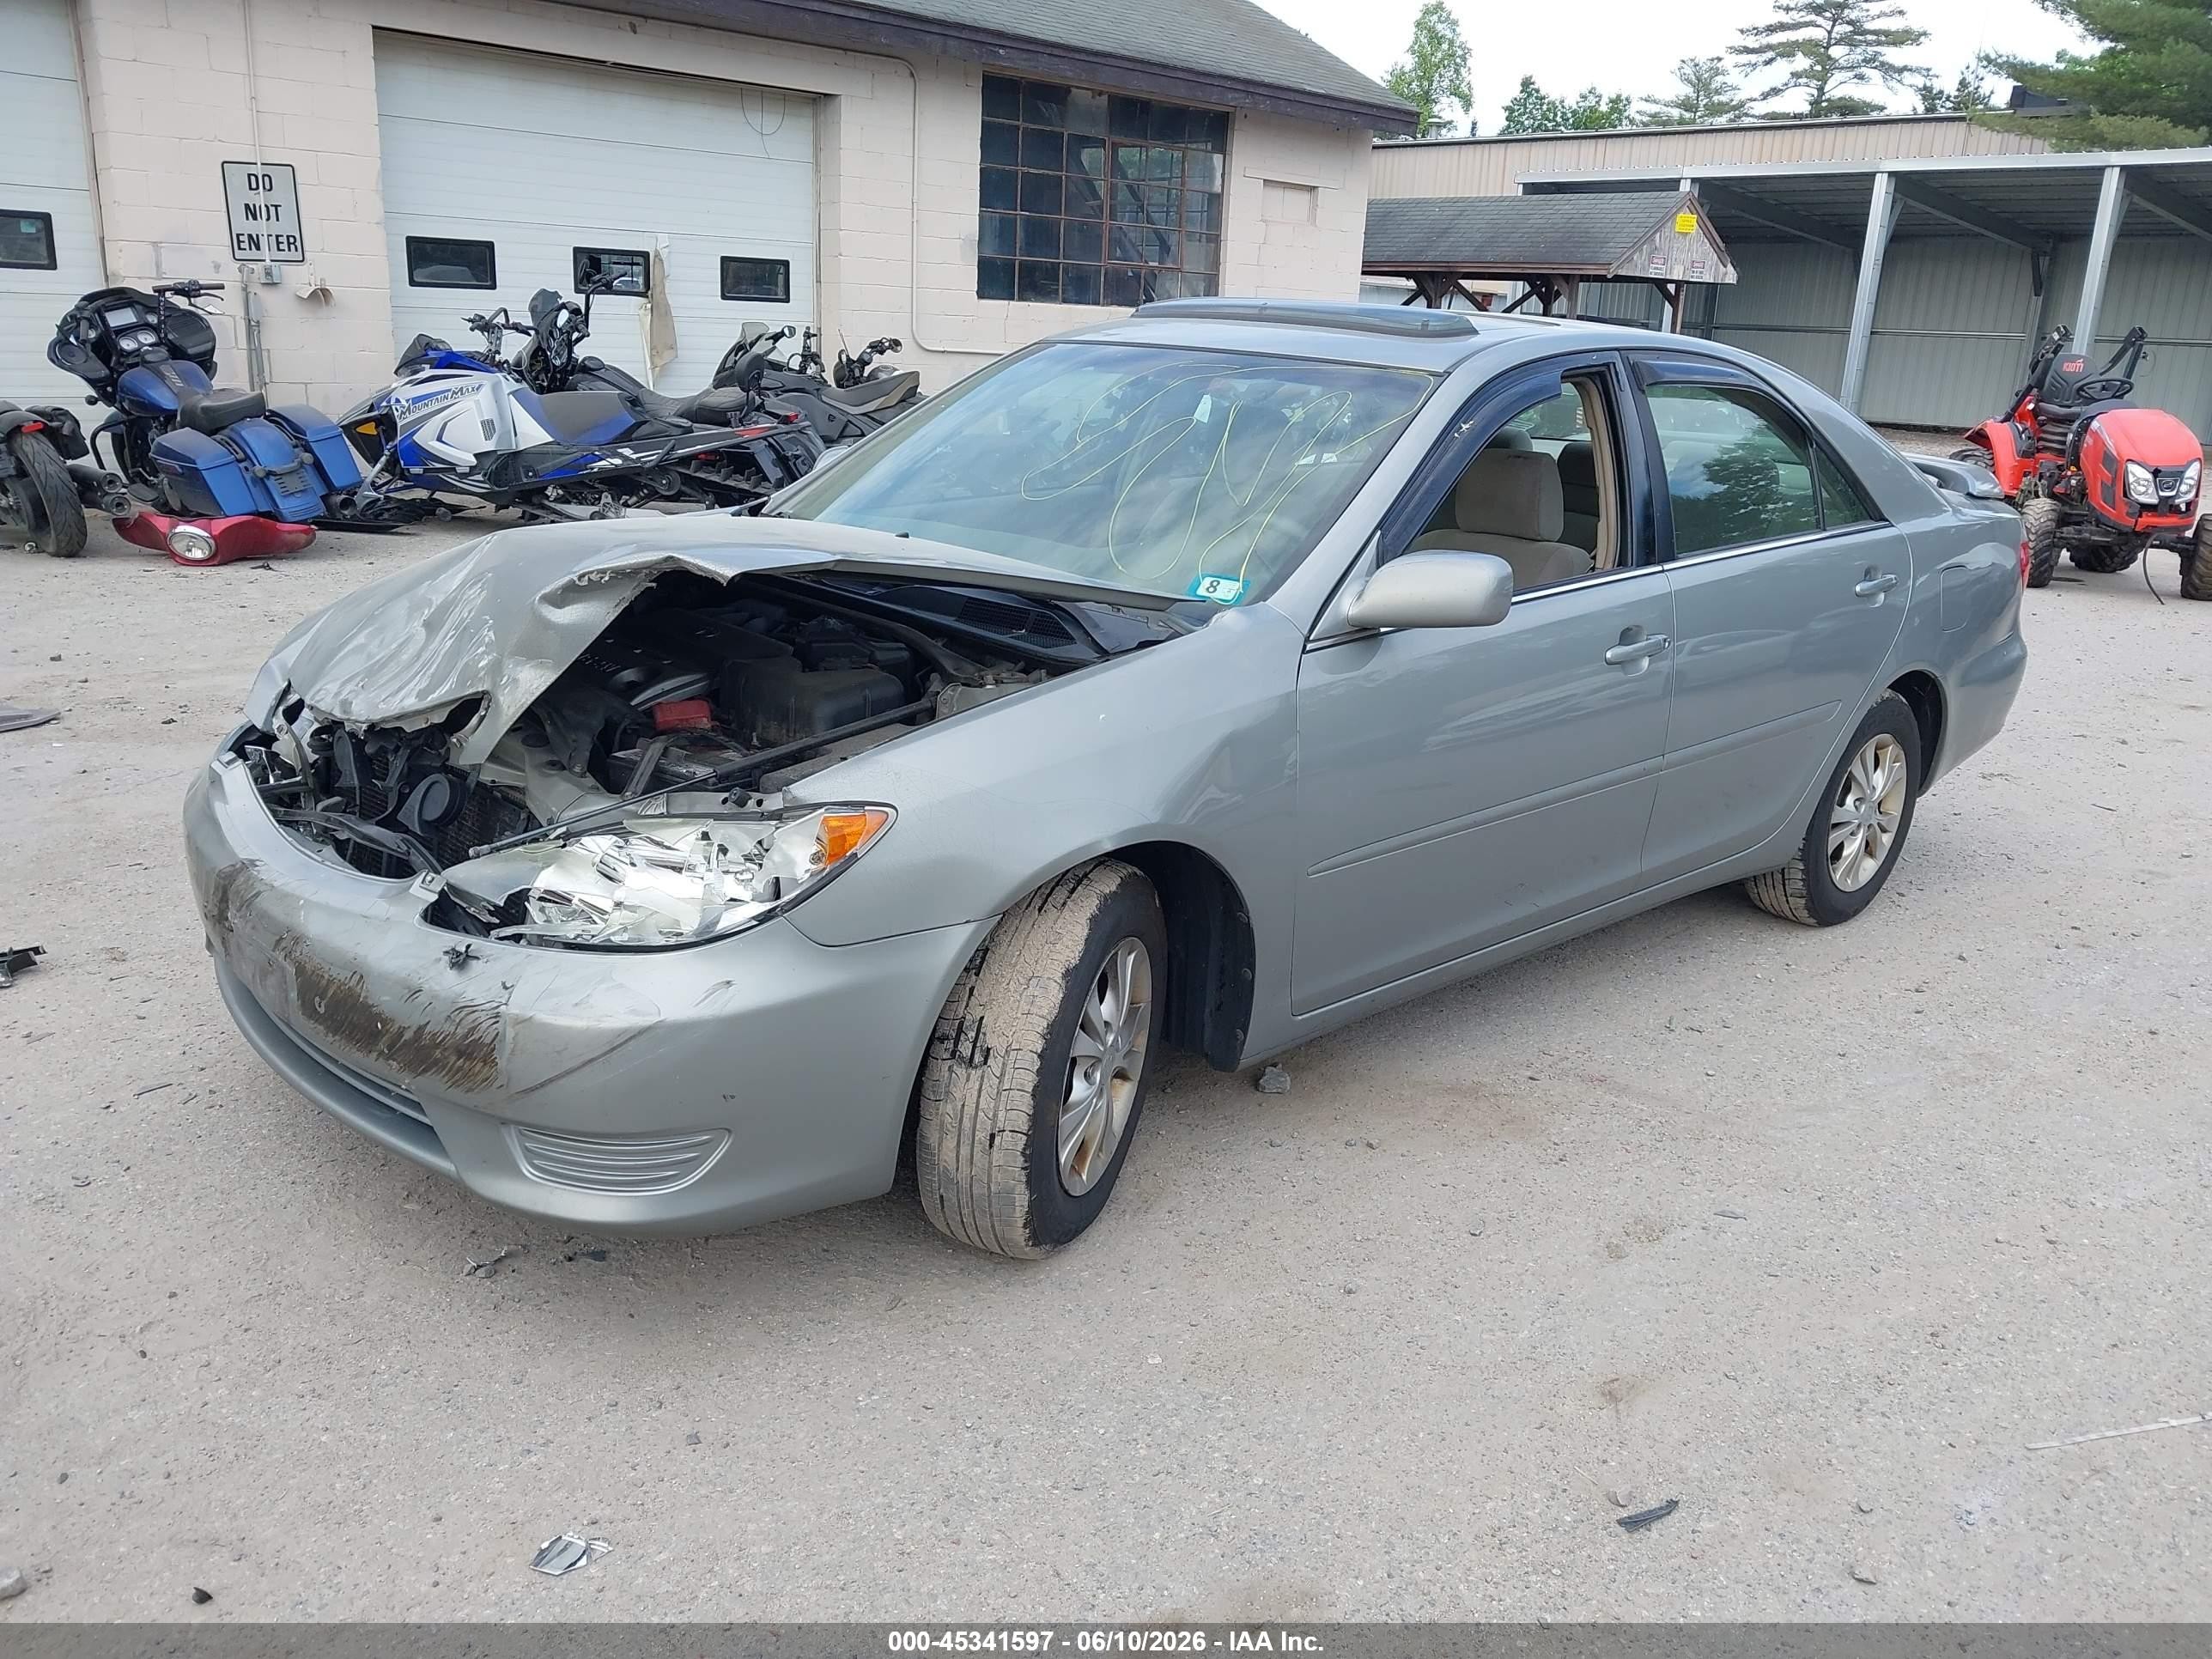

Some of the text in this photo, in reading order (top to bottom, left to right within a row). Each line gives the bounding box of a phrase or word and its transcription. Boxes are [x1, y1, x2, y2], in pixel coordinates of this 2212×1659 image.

[247, 173, 273, 191] DO
[244, 203, 282, 222] NOT
[235, 234, 298, 252] ENTER
[398, 392, 450, 420] MOUNTAIN
[1206, 580, 1220, 593] 8
